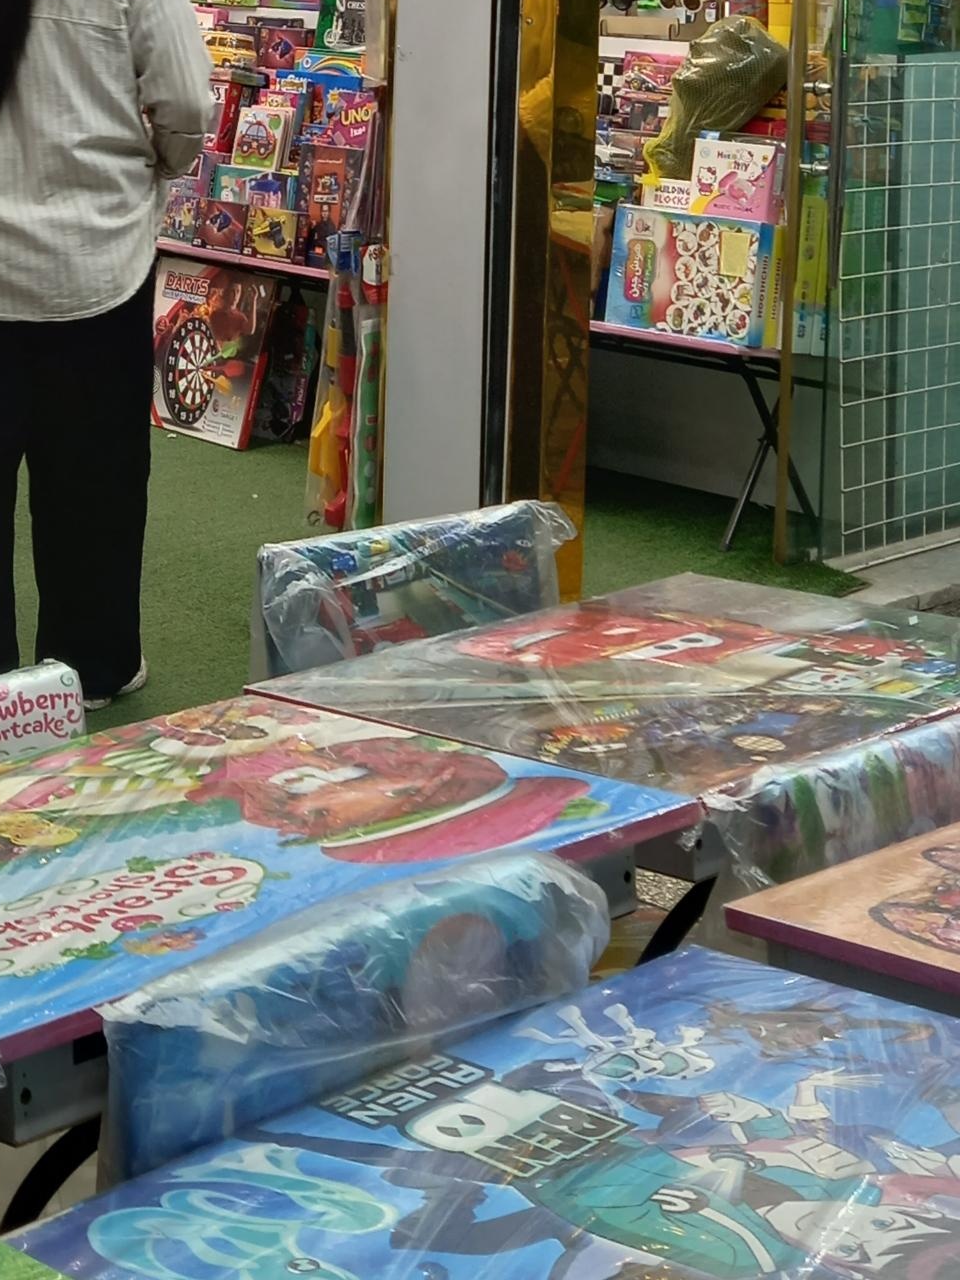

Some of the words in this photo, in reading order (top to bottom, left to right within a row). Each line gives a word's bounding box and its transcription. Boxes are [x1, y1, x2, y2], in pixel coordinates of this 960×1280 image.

[347, 1, 366, 10] CHES
[341, 105, 372, 126] UNO
[165, 271, 211, 296] DARTS
[346, 1063, 487, 1126] ALIEN
[463, 1099, 629, 1179] BEN
